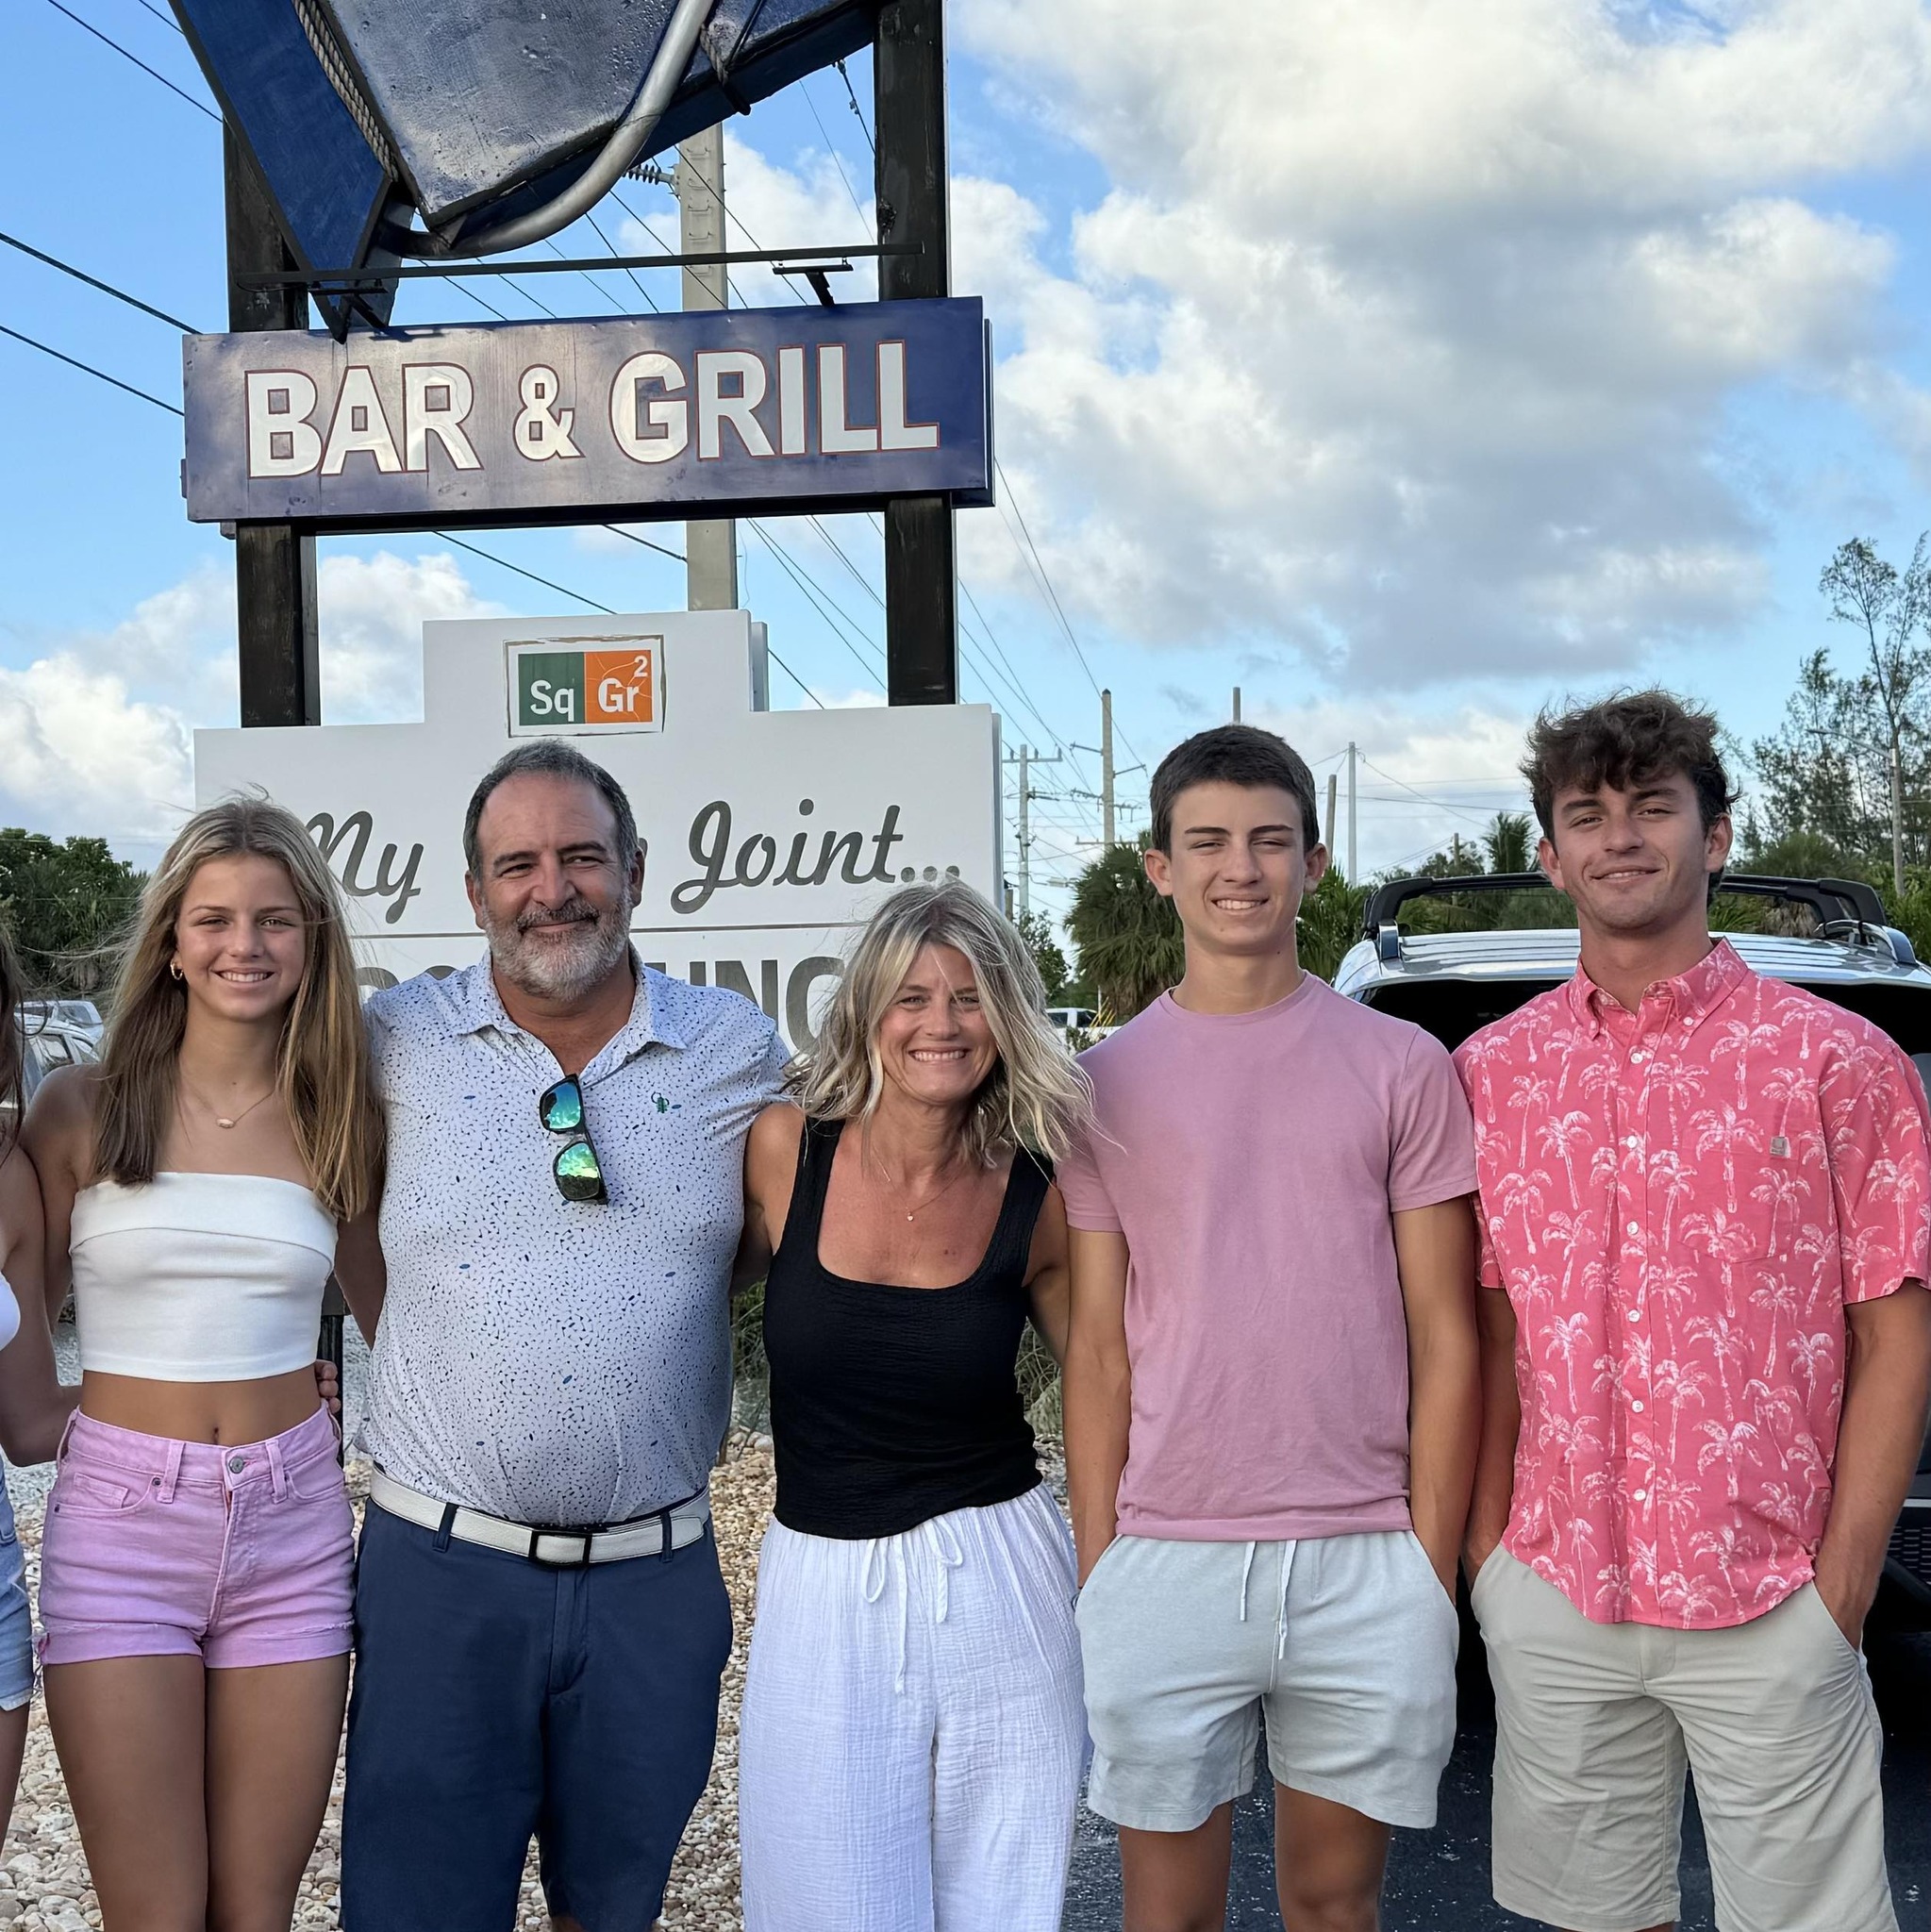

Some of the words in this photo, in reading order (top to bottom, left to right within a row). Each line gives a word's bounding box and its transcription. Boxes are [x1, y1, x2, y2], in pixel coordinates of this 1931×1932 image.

[243, 361, 483, 479] BAR
[513, 363, 585, 462] &
[608, 340, 941, 466] GRILL
[530, 679, 574, 723] Sq
